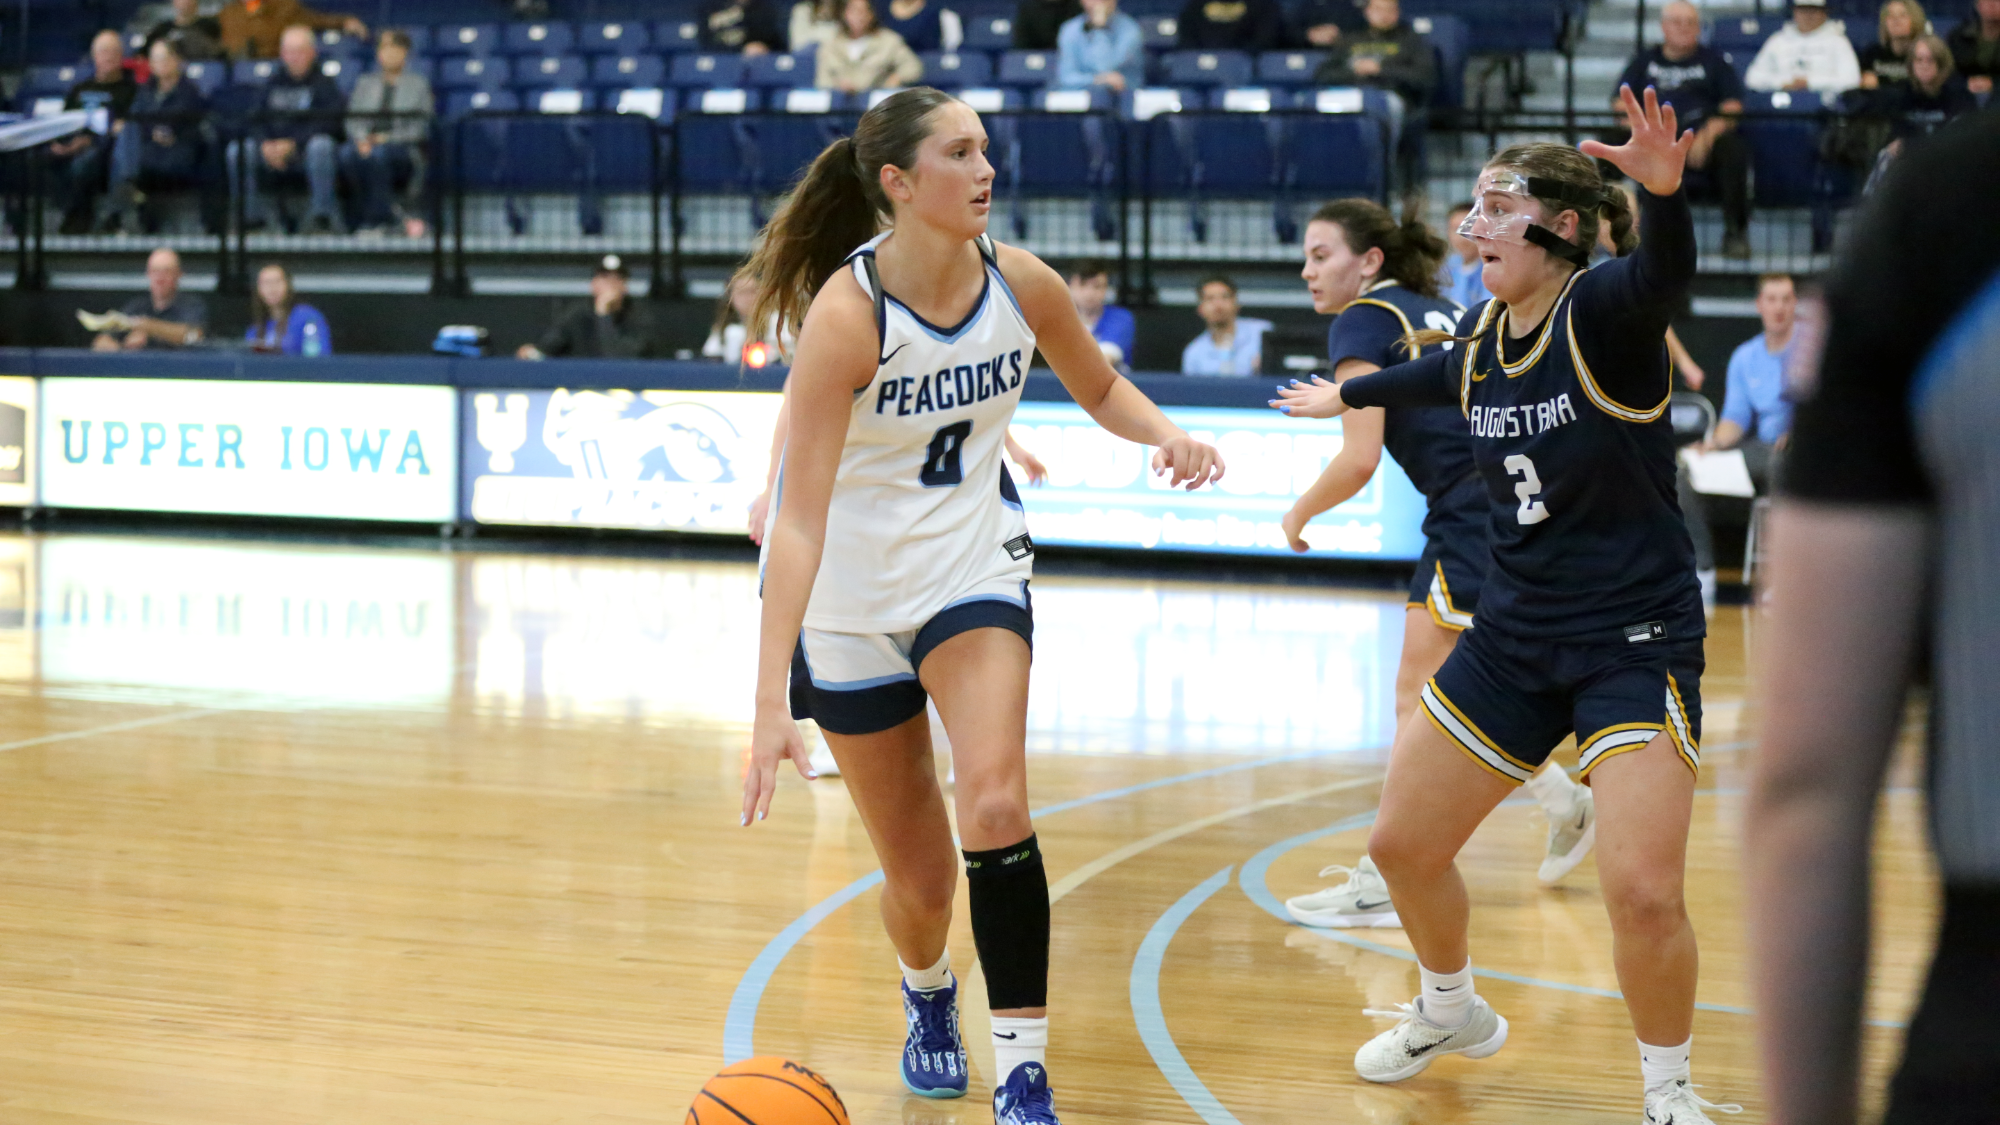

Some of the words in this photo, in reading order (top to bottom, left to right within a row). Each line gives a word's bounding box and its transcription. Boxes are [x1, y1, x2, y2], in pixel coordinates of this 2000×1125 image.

[875, 348, 1022, 417] PEACOCKS
[1470, 392, 1577, 438] AUGUSTANA
[61, 419, 246, 470] UPPER
[280, 426, 431, 475] IOWA
[917, 418, 975, 489] 0
[1503, 453, 1551, 525] 2
[1653, 625, 1663, 635] M
